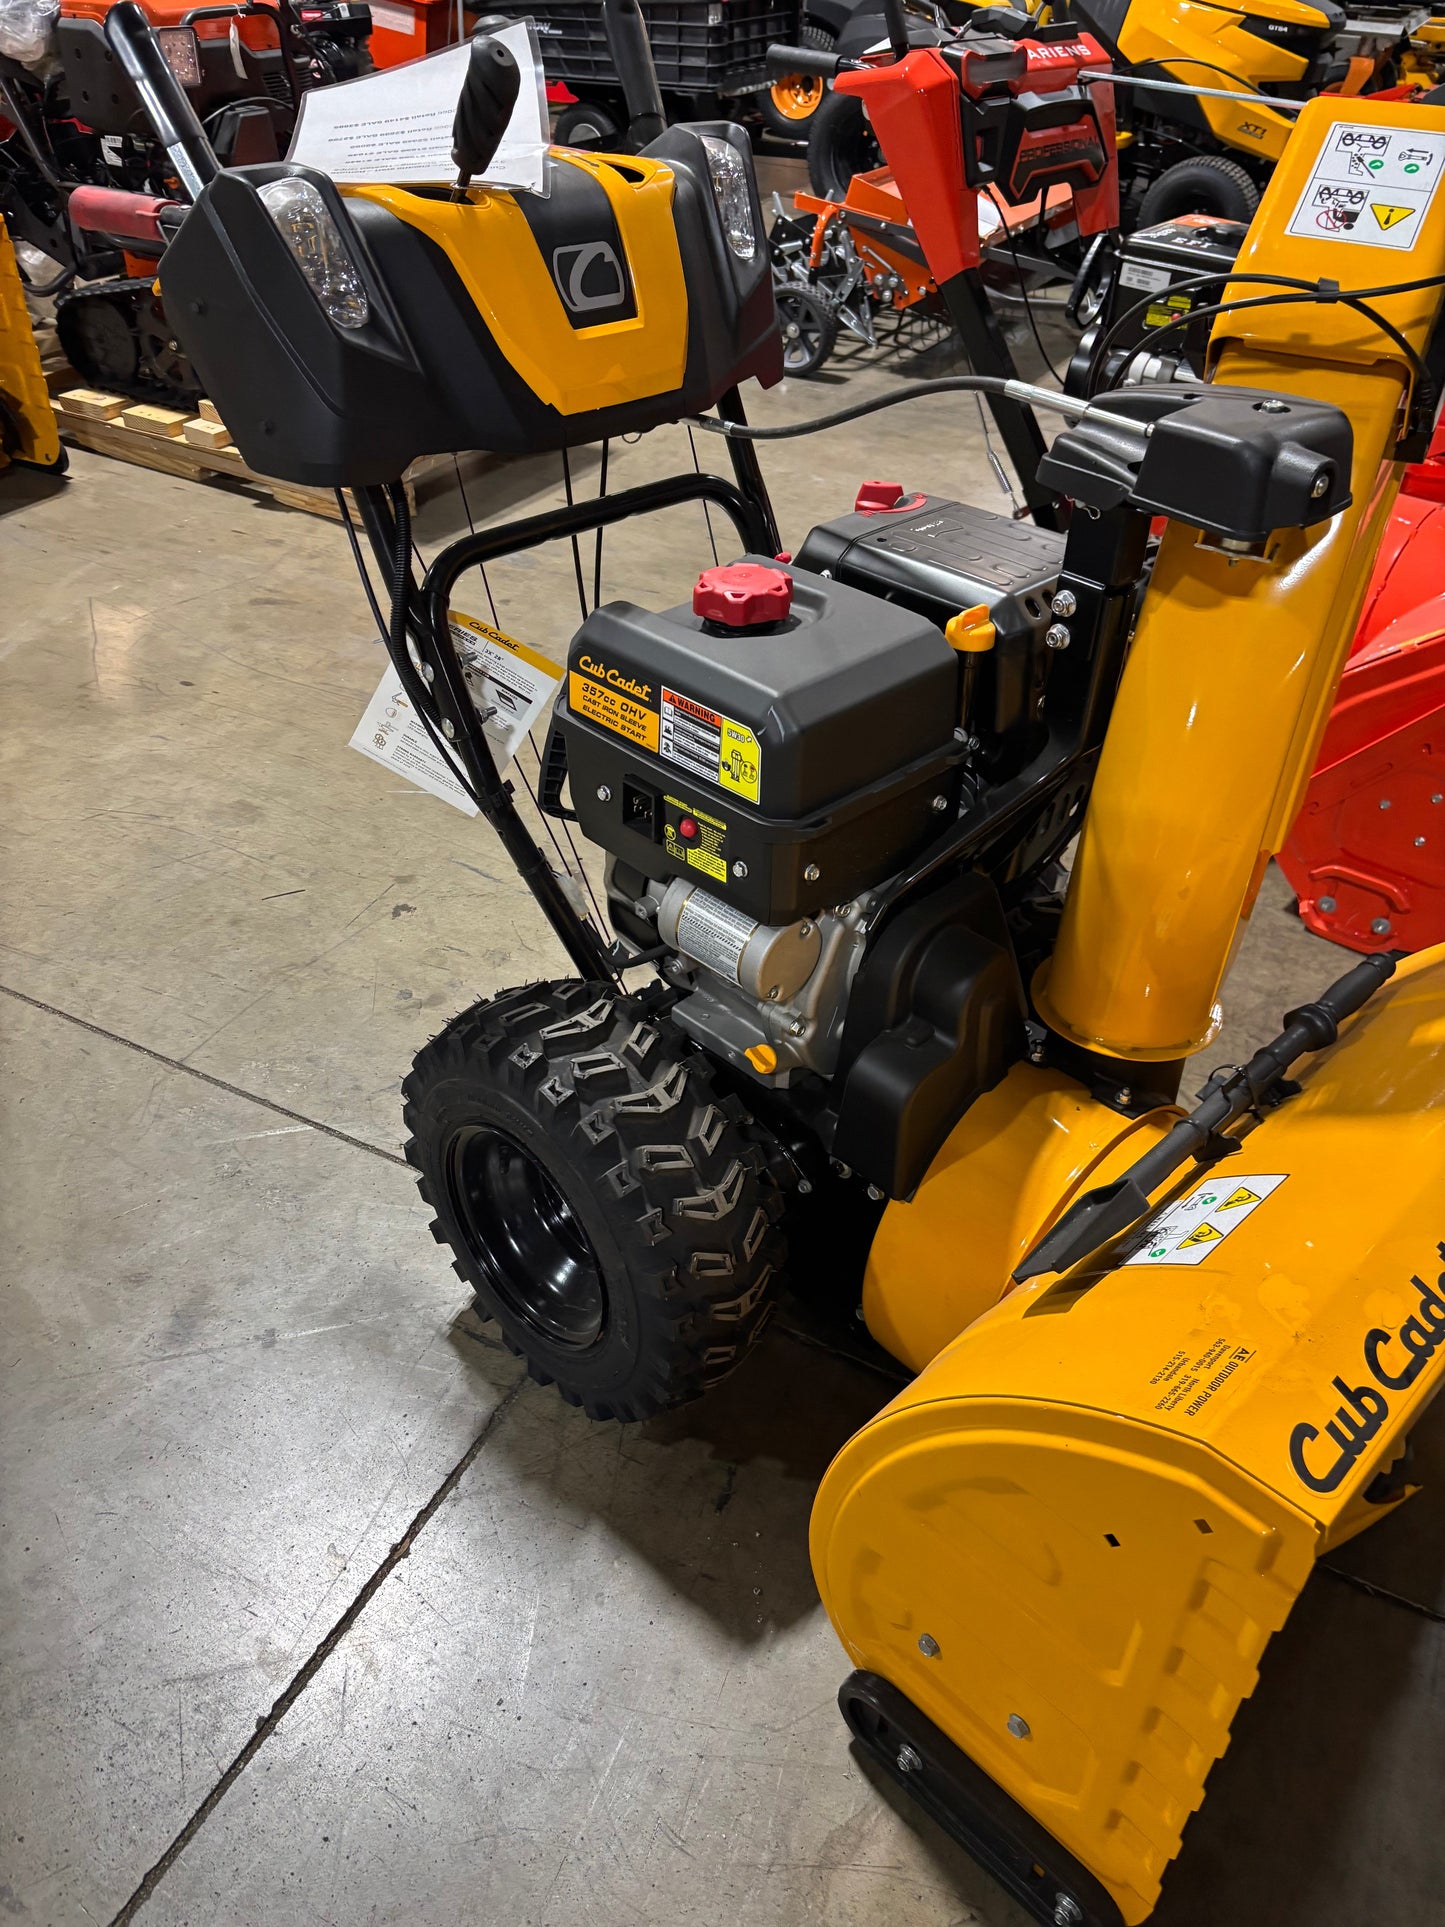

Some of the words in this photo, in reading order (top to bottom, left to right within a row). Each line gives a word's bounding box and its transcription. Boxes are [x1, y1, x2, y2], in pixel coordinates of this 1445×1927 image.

[1027, 45, 1092, 60] ARIENS
[1241, 122, 1267, 135] XT1
[469, 621, 488, 634] Cub
[488, 632, 520, 651] Cadet
[579, 655, 606, 679] Cub
[606, 669, 652, 702] Cadet
[581, 683, 617, 706] 357cc
[620, 702, 647, 720] OHV
[582, 695, 601, 707] CAST
[602, 705, 619, 718] IRON
[620, 713, 647, 732] SLEEVE
[677, 697, 715, 723] WARNING
[582, 704, 619, 727] ELECTRIC
[620, 724, 647, 741] START
[727, 728, 745, 743] 5W30
[1204, 1345, 1231, 1369] Davenport
[1233, 1348, 1250, 1361] AE
[1163, 1357, 1191, 1382] Urbandale
[1206, 1361, 1239, 1392] OUTDOOR
[1182, 1378, 1200, 1393] North
[1164, 1393, 1186, 1411] Liberty
[1184, 1391, 1213, 1416] POWER
[1289, 1375, 1389, 1494] Cub
